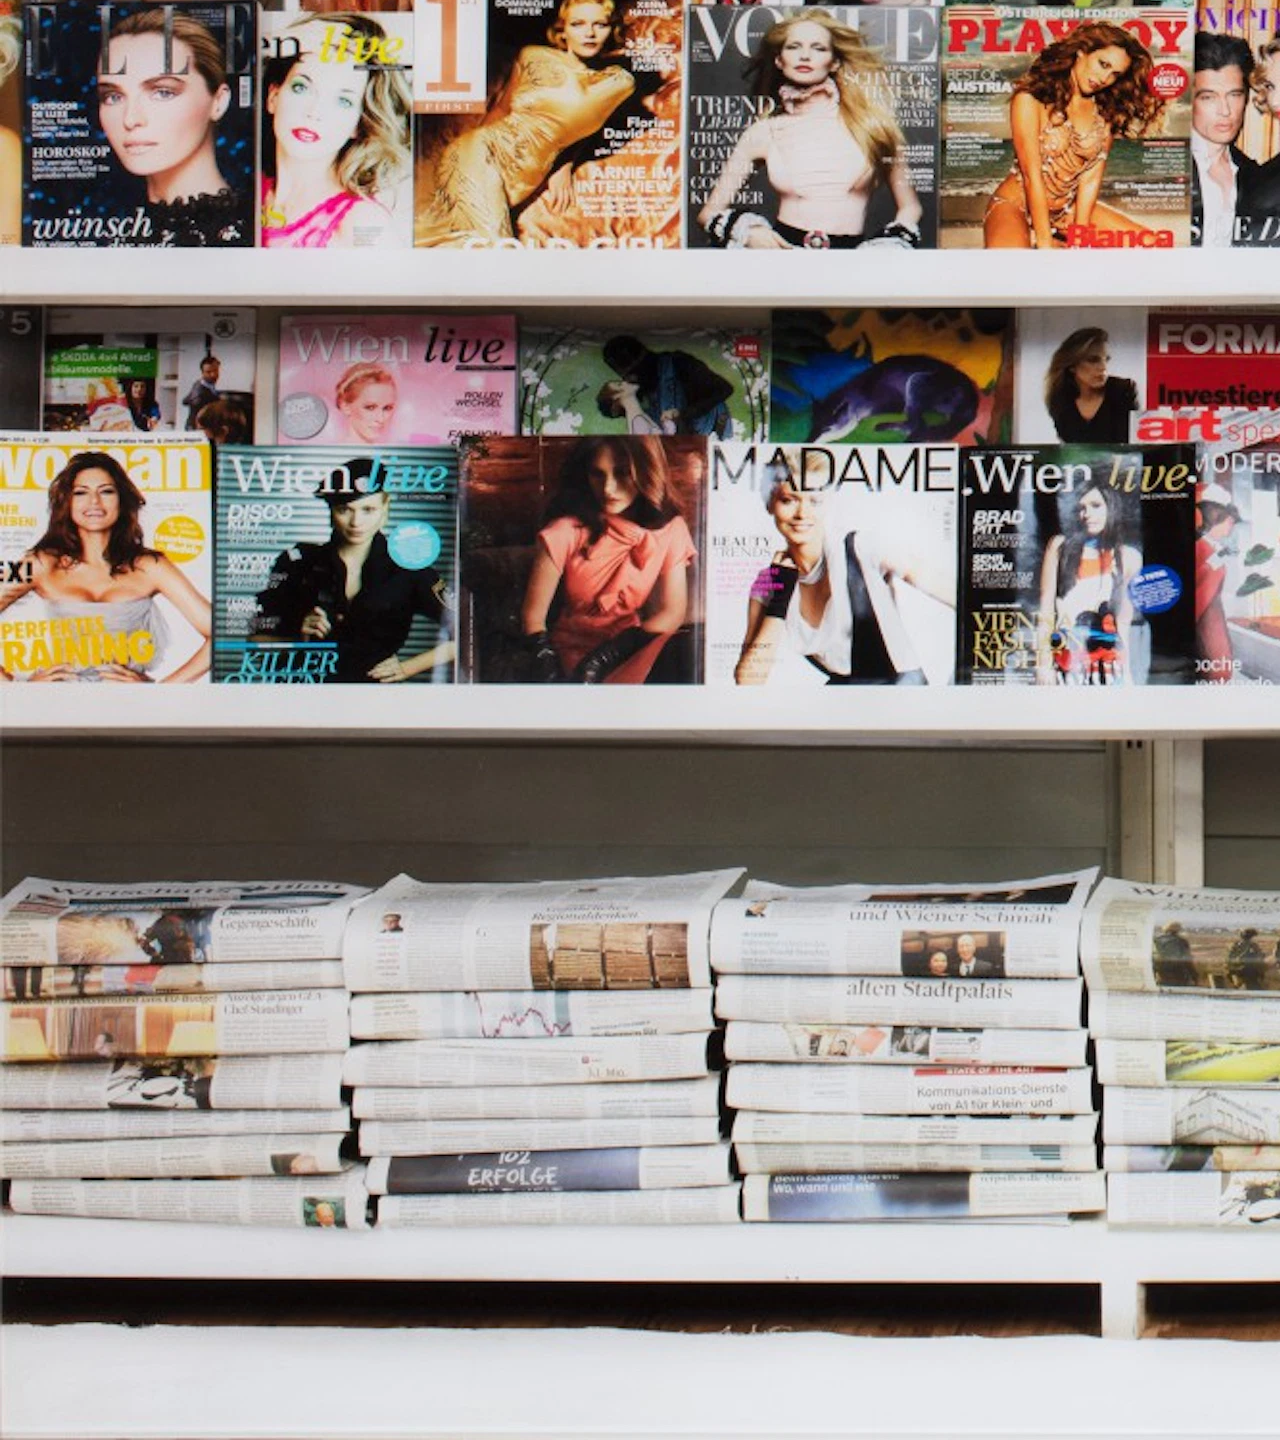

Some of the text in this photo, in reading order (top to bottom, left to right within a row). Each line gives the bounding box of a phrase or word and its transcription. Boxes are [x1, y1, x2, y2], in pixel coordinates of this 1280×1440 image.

[30, 6, 249, 75] ELLE
[318, 25, 403, 64] live
[946, 81, 1013, 92] AUSTRIA
[32, 146, 110, 158] HOROSKOP
[32, 210, 151, 238] wünsch
[291, 326, 505, 364] Wien live
[232, 456, 447, 492] Wien live
[712, 447, 954, 492] MADAME
[973, 510, 1026, 524] BRAD
[973, 524, 1004, 534] PITT
[242, 650, 340, 672] KILLER
[847, 982, 1014, 1000] alten Stadtpalais
[468, 1168, 557, 1185] ERFOLGE
